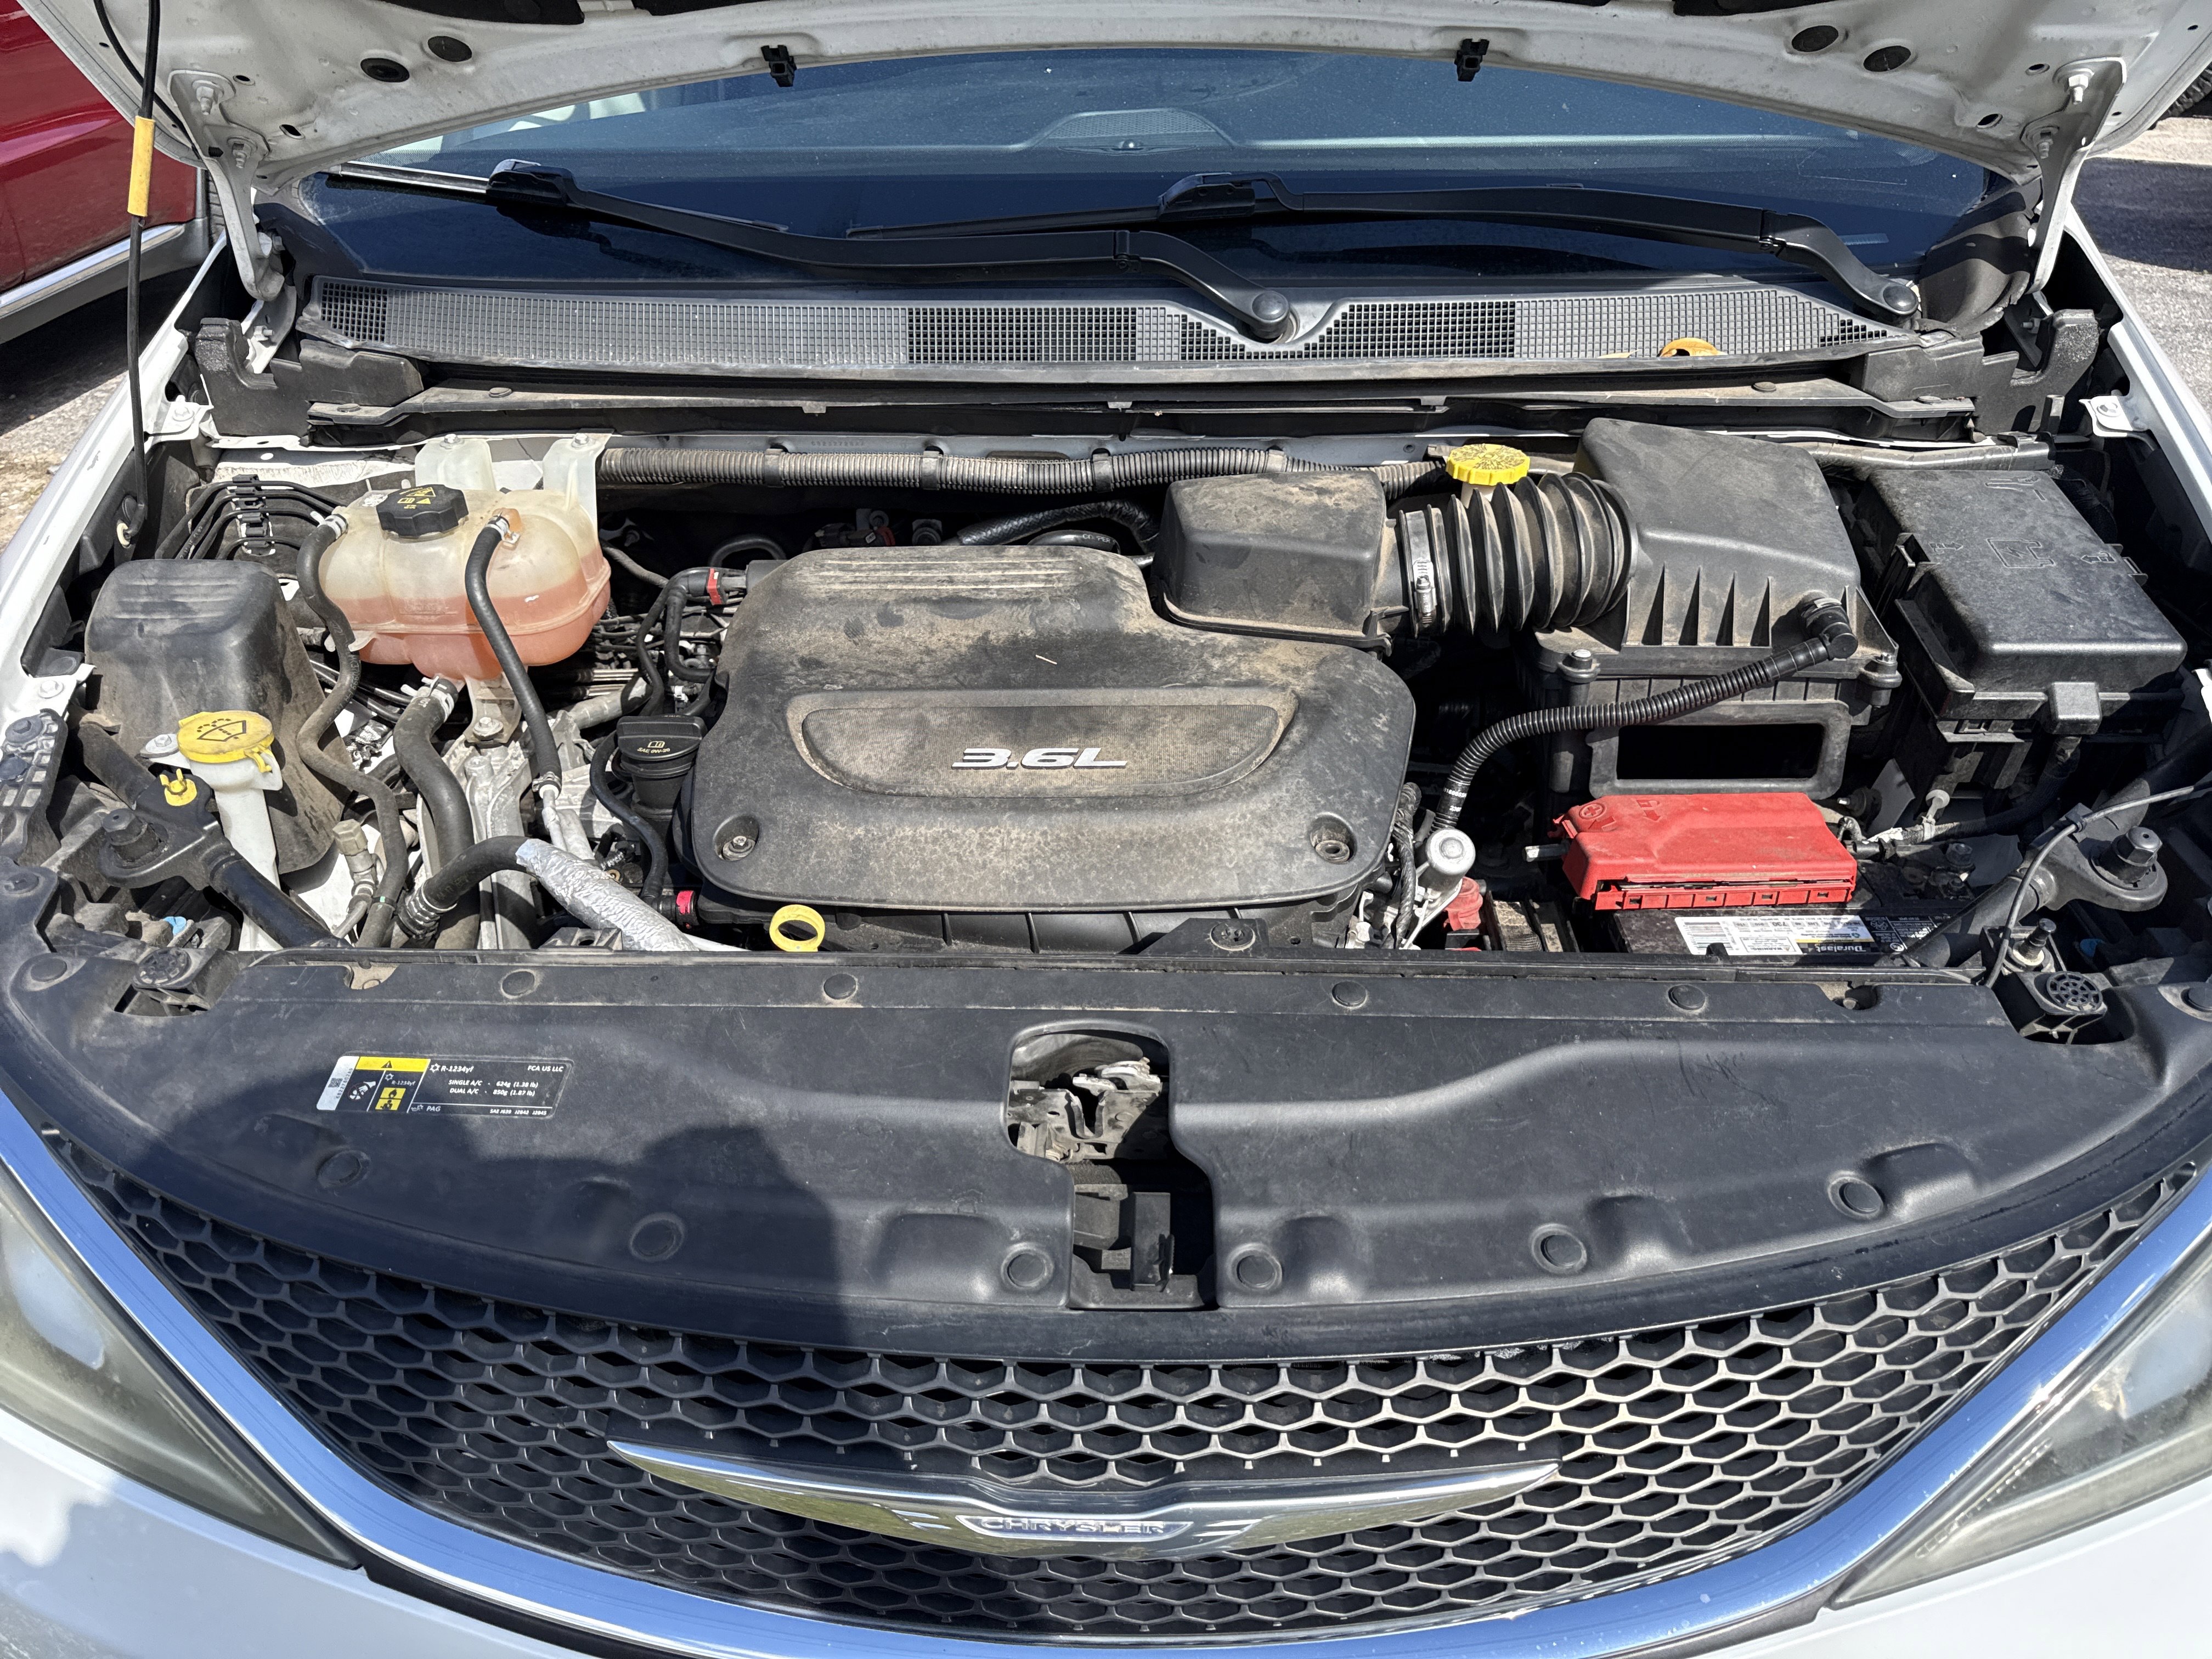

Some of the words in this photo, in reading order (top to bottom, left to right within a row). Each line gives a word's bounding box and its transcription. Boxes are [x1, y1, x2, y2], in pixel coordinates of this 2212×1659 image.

[951, 747, 1128, 769] 3.6L
[1815, 945, 1867, 953] Duralast
[441, 1065, 475, 1074] R-1234yf
[980, 1517, 1165, 1534] CHRYSLER
